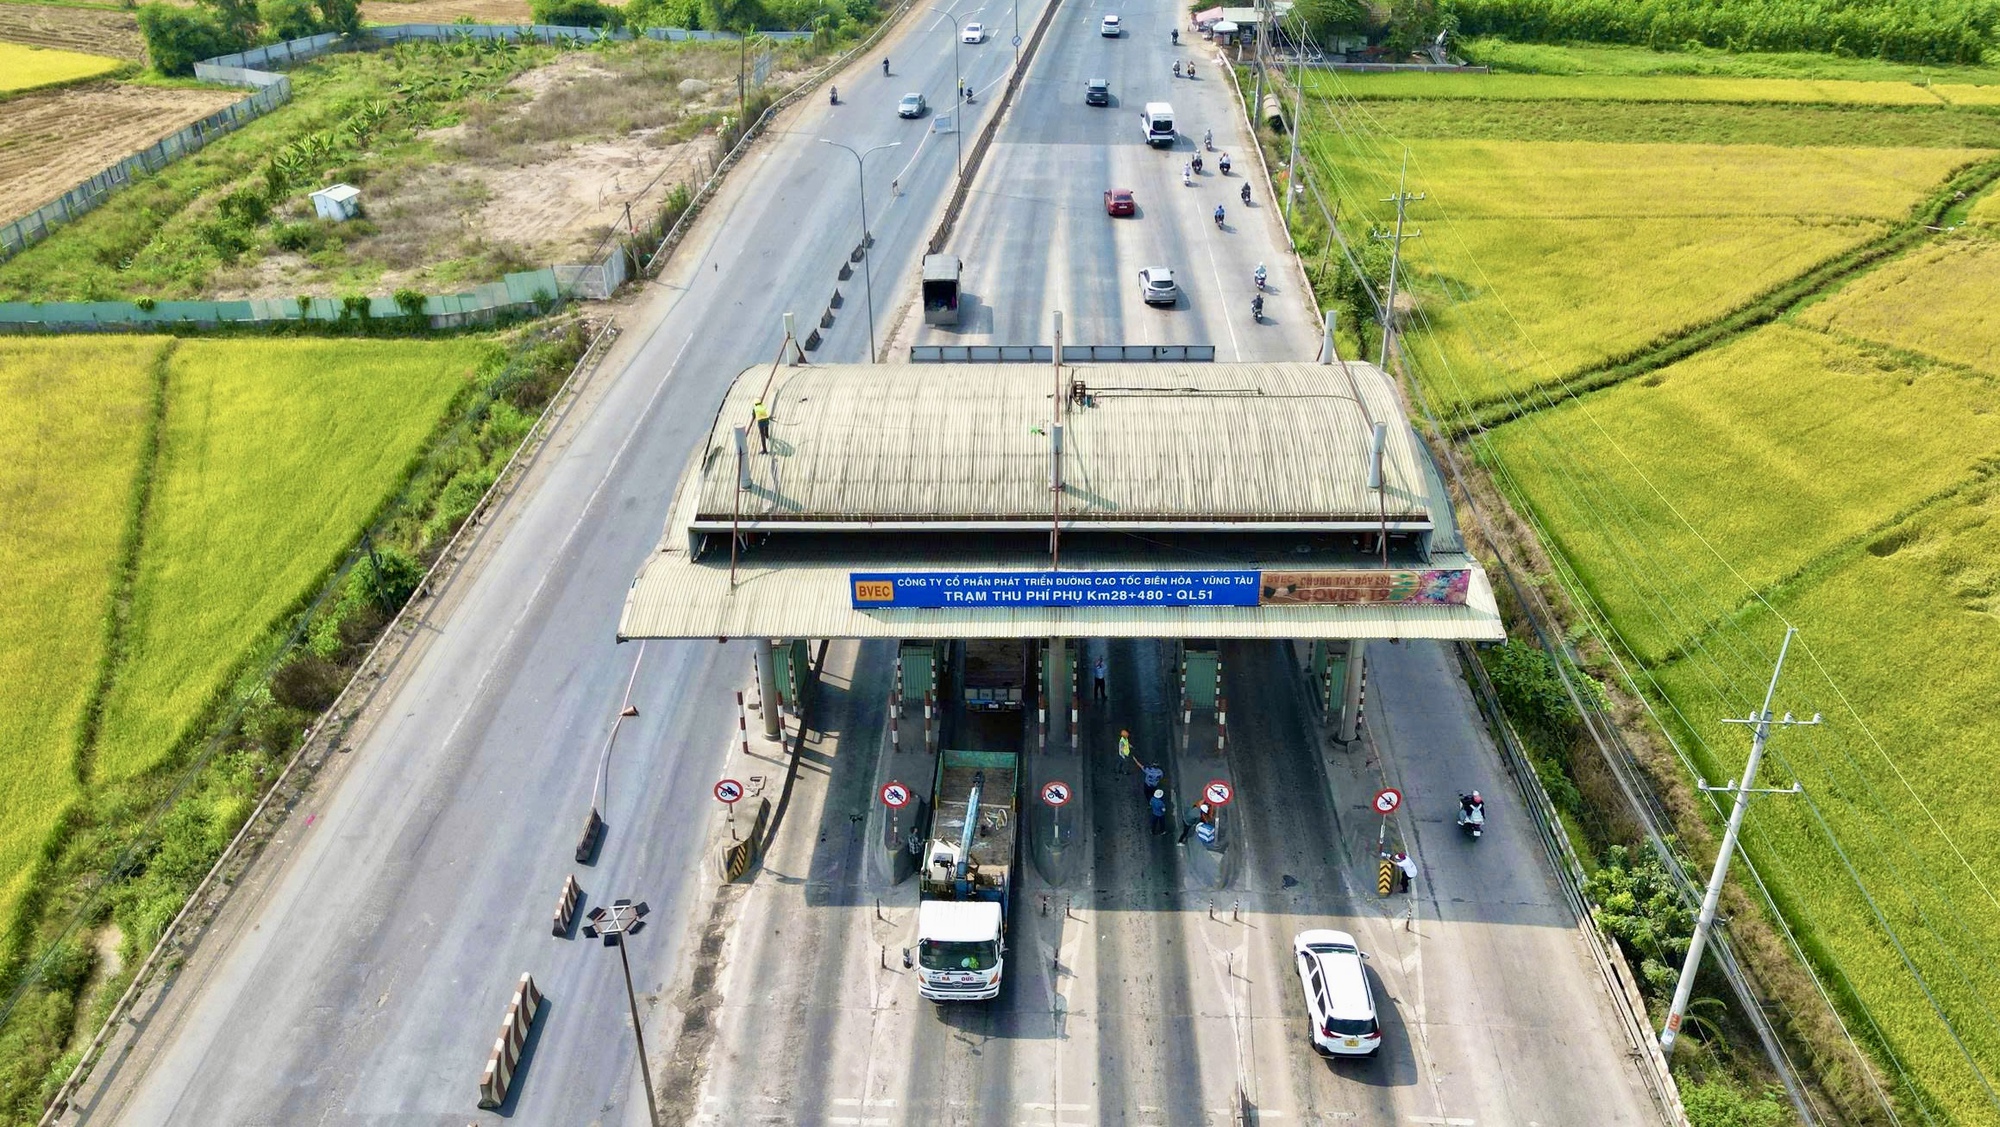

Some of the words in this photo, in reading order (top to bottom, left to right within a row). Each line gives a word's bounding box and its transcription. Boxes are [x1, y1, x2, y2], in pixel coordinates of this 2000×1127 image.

[897, 577, 927, 587] CÔNG
[929, 578, 942, 587] TY
[945, 575, 960, 587] CỔ
[994, 576, 1020, 587] PHÁT
[1024, 574, 1053, 586] TRIỂN
[1056, 575, 1092, 586] ĐƯỜNG
[1095, 577, 1117, 586] CAO
[1119, 574, 1141, 585] TỐC
[1144, 575, 1168, 585] BIÊN
[1170, 575, 1192, 585] HÒA
[1202, 575, 1231, 585] VŨNG
[1234, 575, 1254, 585] TÀU
[1266, 575, 1295, 583] BVEC
[859, 586, 891, 597] BVEC
[943, 591, 987, 604] TRẠM
[992, 590, 1022, 601] THU
[1026, 588, 1051, 601] PHÍ
[1052, 590, 1083, 604] PHỤ
[1087, 590, 1164, 601] Km28+480
[1176, 589, 1213, 600] QL51
